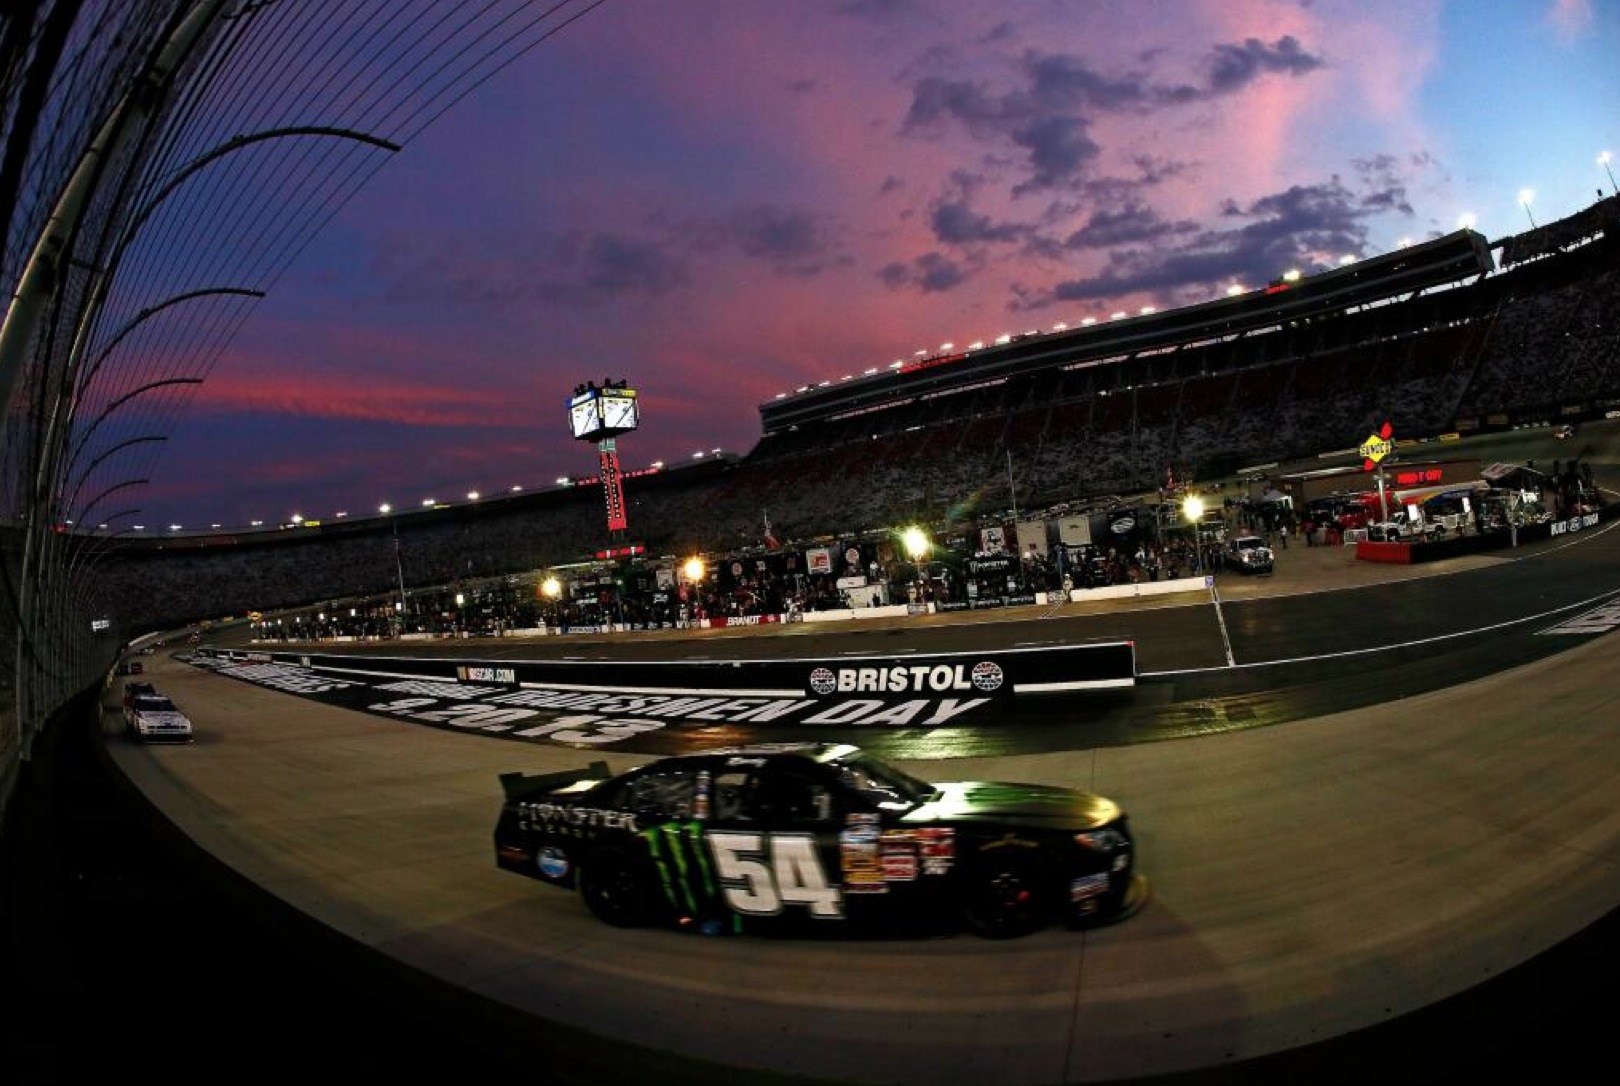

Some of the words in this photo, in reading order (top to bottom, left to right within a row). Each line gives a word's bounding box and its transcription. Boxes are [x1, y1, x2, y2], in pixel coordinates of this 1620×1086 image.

[726, 615, 762, 626] BRANDT
[837, 664, 971, 692] BRISTOL
[367, 698, 668, 744] 9.20.13
[800, 699, 992, 725] DAY
[704, 829, 846, 919] 54
